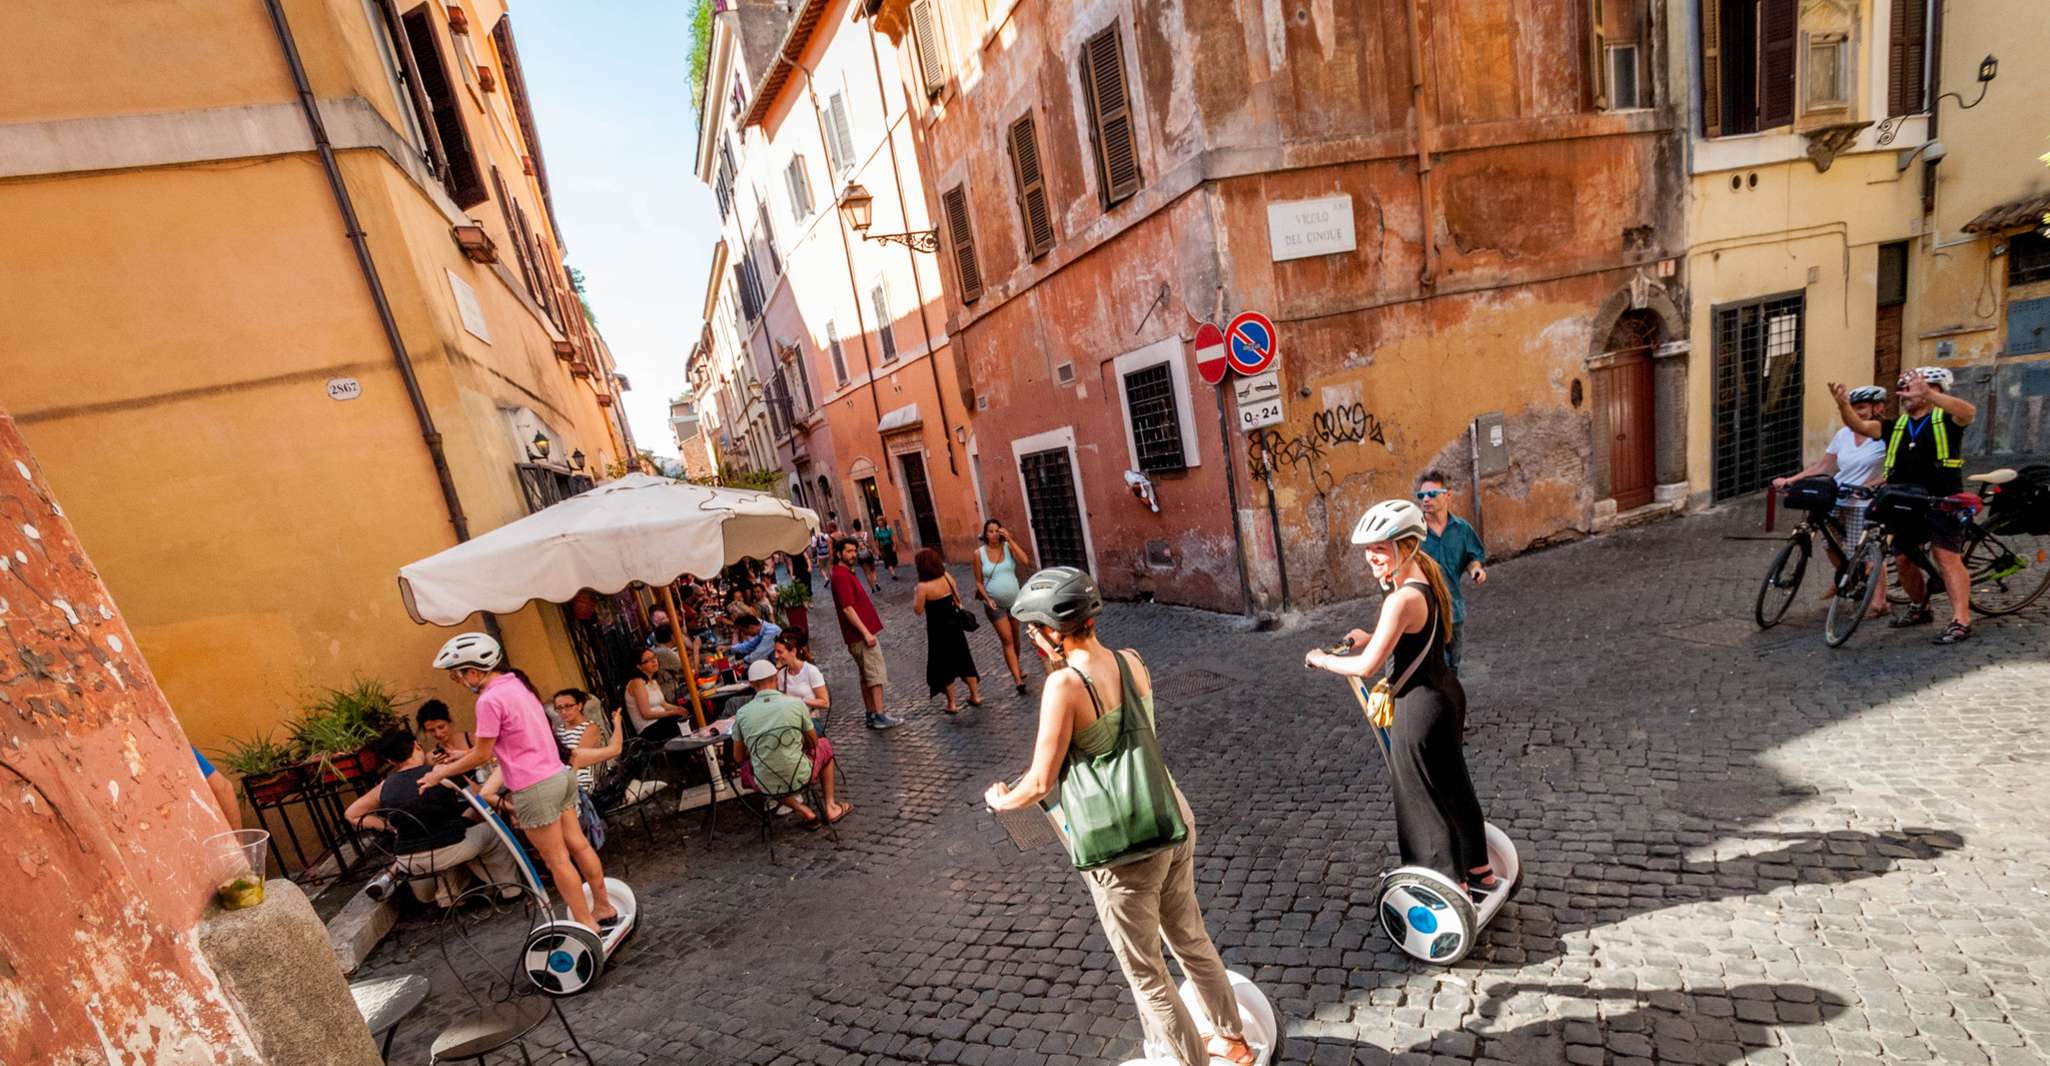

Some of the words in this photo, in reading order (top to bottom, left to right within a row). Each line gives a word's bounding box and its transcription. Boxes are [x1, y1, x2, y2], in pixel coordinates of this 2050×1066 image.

[1295, 210, 1329, 225] VICOLO
[1284, 233, 1302, 246] DEL
[330, 381, 357, 395] 2867
